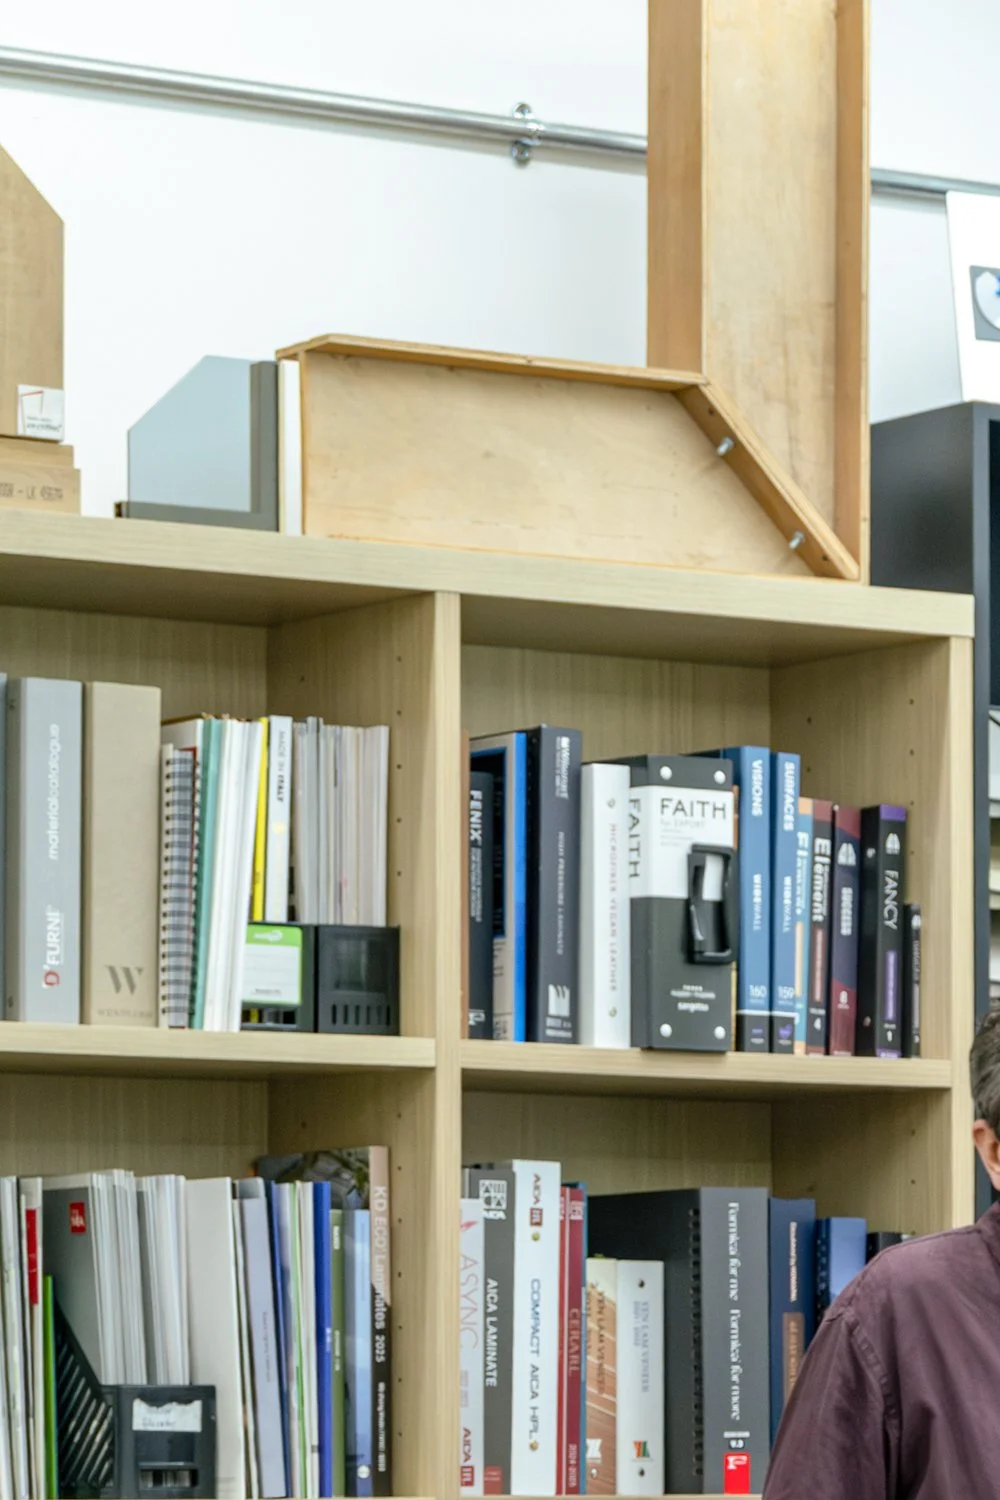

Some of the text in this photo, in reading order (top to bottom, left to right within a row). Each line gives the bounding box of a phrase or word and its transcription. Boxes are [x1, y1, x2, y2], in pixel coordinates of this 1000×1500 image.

[751, 759, 764, 816] VISIONS
[783, 761, 796, 831] SURFACES
[470, 790, 483, 841] FENIX
[660, 798, 727, 820] FAITH
[629, 798, 641, 878] FAITH
[812, 837, 832, 922] Element
[883, 869, 900, 930] FANCY
[749, 985, 768, 999] 160
[778, 986, 795, 999] 159
[375, 1186, 387, 1212] KD
[532, 1174, 541, 1204] AICA
[728, 1257, 741, 1278] for
[728, 1279, 739, 1302] me
[485, 1278, 498, 1387] AICA LAMINATE
[528, 1279, 541, 1440] COMPACT AICA HPL
[731, 1364, 743, 1385] for
[730, 1386, 741, 1421] more
[463, 1427, 472, 1463] AICA
